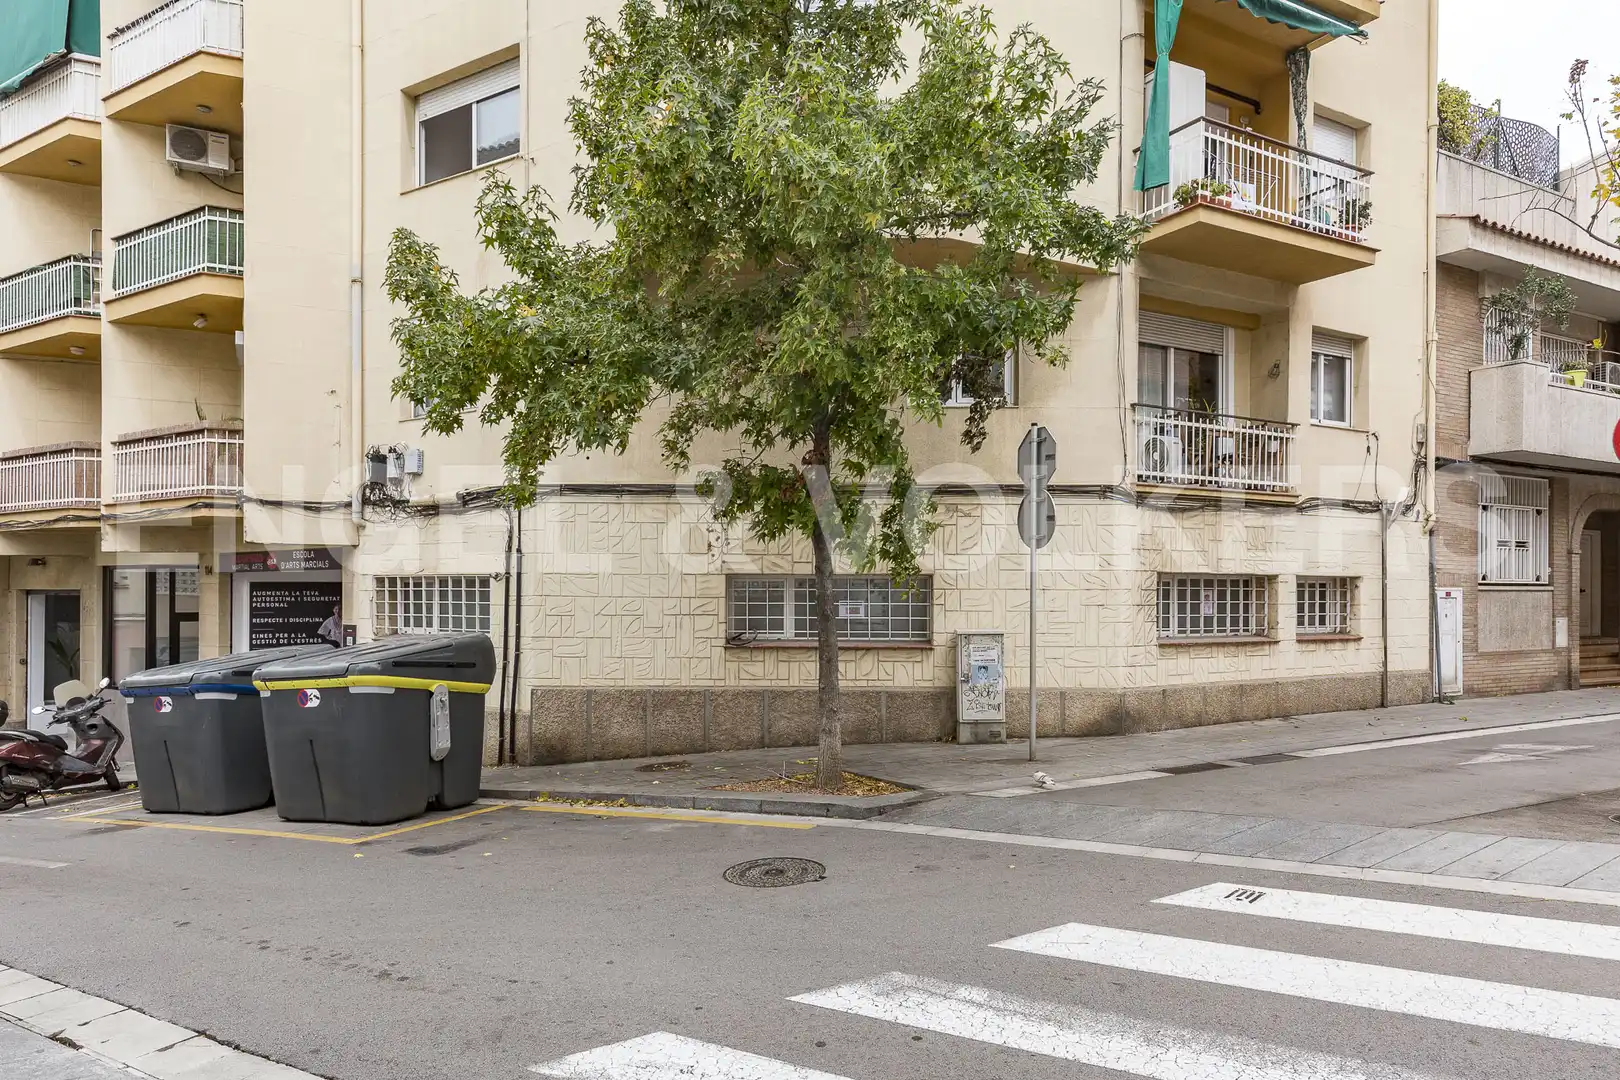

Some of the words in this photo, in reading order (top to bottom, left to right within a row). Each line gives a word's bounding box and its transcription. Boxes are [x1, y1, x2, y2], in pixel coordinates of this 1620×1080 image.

[292, 550, 315, 559] ESCOLA
[280, 561, 300, 569] D'ARTS
[300, 560, 330, 568] MARCIALS
